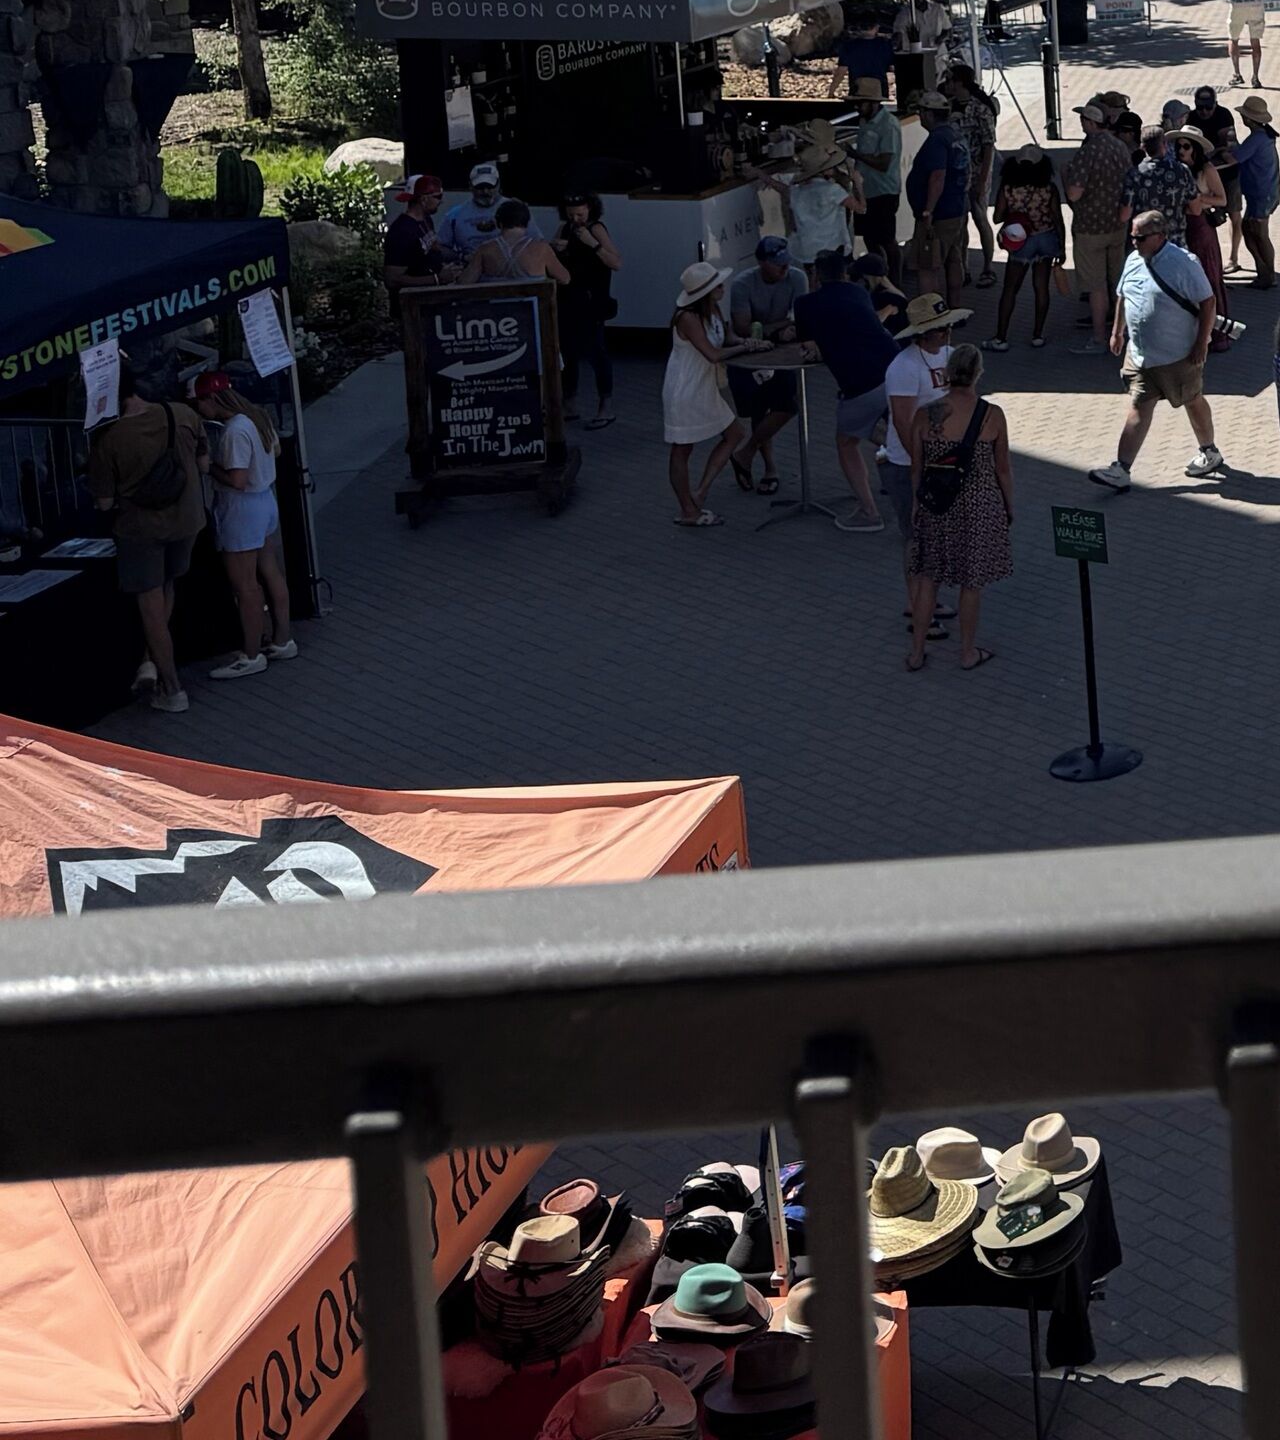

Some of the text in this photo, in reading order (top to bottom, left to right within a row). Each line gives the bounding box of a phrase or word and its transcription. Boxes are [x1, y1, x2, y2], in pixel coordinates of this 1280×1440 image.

[432, 2, 667, 19] BOURBON COMPANY
[1105, 1, 1133, 9] POINT
[558, 42, 647, 74] BOURBON COMPANY
[0, 255, 276, 381] STONEFESTIVALS.COM
[434, 314, 519, 340] Lime
[440, 407, 495, 423] Happy
[449, 423, 491, 438] Hour
[442, 439, 466, 456] In
[468, 436, 500, 453] The
[1060, 512, 1096, 529] PLEASE
[1056, 526, 1083, 540] WALK
